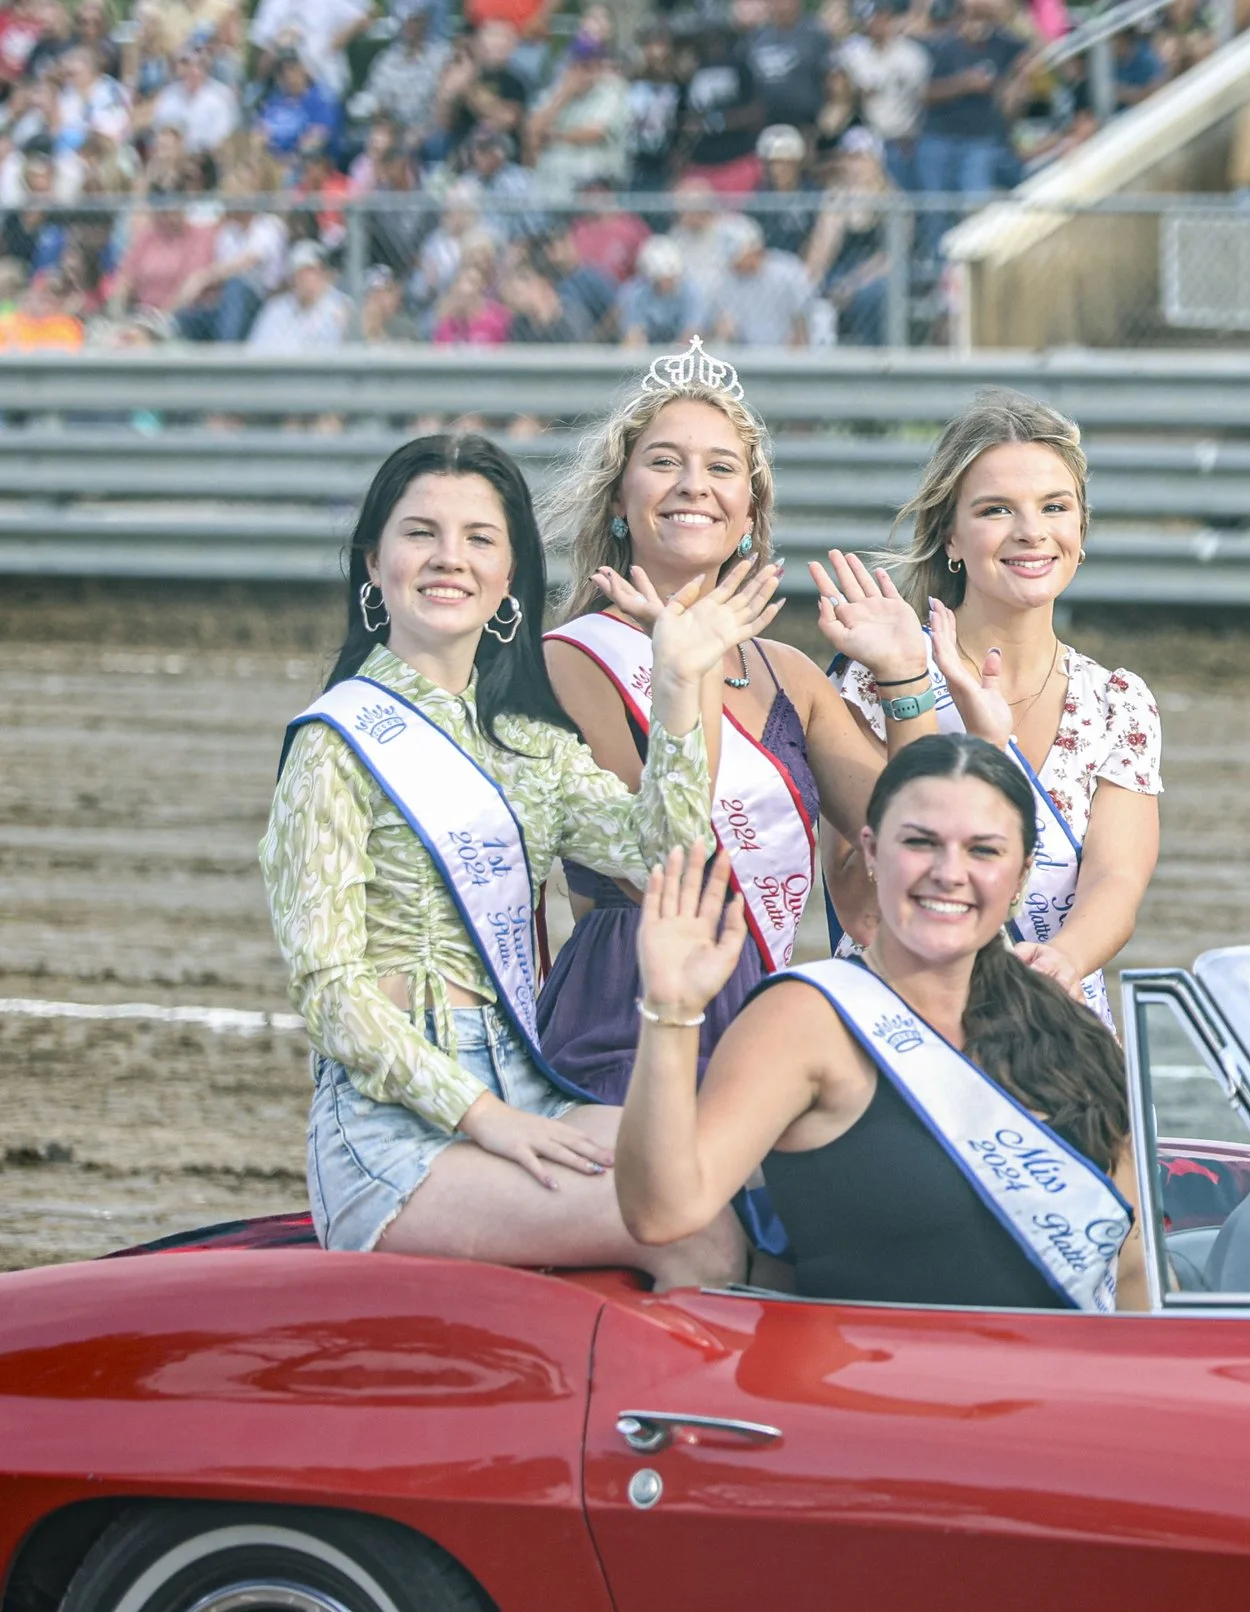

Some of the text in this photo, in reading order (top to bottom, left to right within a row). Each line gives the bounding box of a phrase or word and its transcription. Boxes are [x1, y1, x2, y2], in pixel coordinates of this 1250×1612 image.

[720, 799, 763, 852] 2024
[482, 836, 513, 878] 1st
[447, 830, 490, 887] 2024
[487, 911, 511, 971] Platte
[753, 876, 785, 931] Platte
[1025, 891, 1050, 942] Platte
[994, 1128, 1068, 1194] Miss
[967, 1138, 1089, 1273] 2024 Platte
